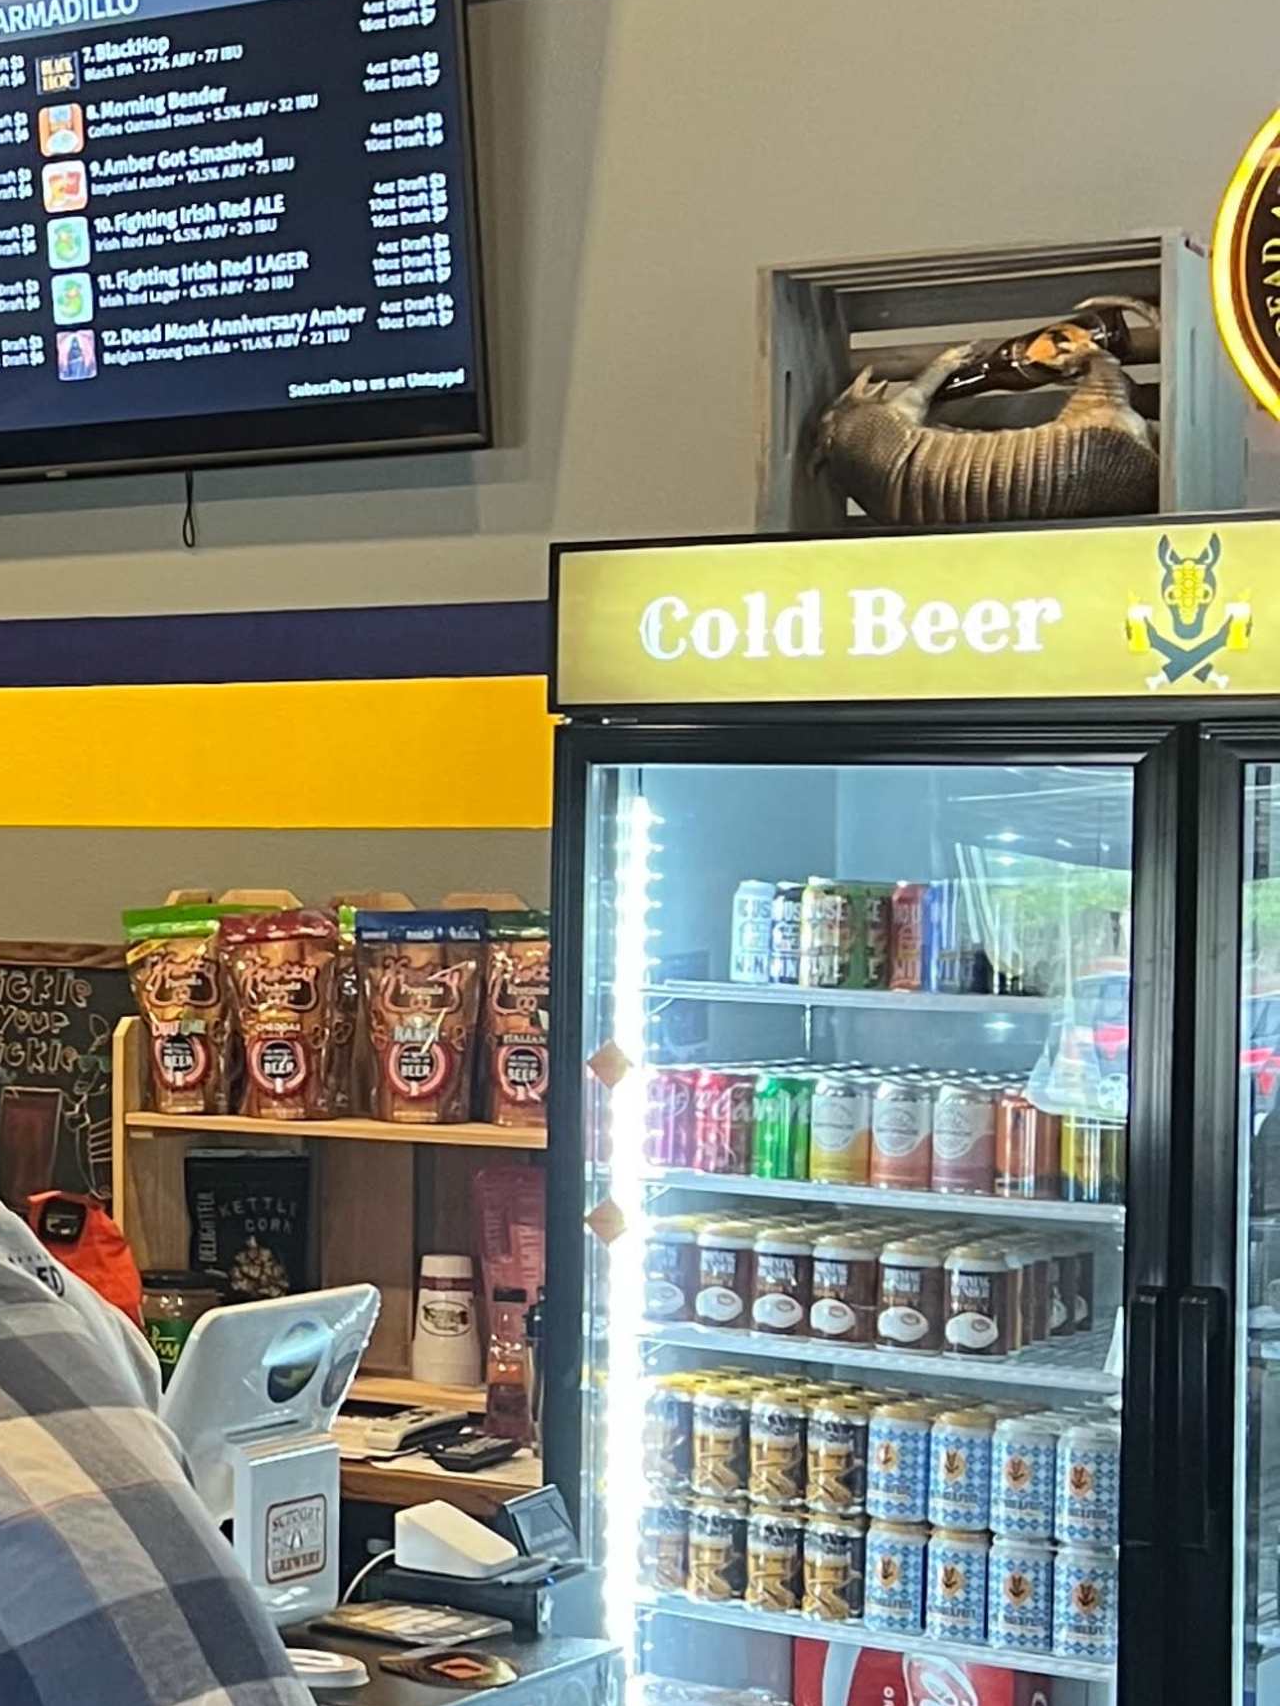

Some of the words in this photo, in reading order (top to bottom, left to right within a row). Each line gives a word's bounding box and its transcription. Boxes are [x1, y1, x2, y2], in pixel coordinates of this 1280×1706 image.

[168, 86, 227, 108] Bender
[158, 148, 187, 170] Got
[190, 137, 263, 165] Smashed
[180, 203, 216, 224] Irish
[219, 199, 250, 220] Red
[253, 194, 285, 215] ALE
[182, 259, 217, 281] Irish
[221, 255, 253, 276] Red
[256, 251, 309, 274] LAGER
[165, 317, 209, 341] Monk
[211, 312, 307, 337] Anniversary
[310, 305, 366, 326] Amber
[289, 379, 351, 398] Subscribe
[353, 379, 367, 392] to
[370, 378, 385, 390] us
[388, 376, 405, 389] on
[639, 588, 825, 660] Cold
[847, 588, 1063, 656] Beer
[164, 1055, 193, 1067] BEER
[263, 1062, 294, 1074] BEER
[401, 1065, 430, 1077] BEER
[507, 1068, 539, 1081] BEER
